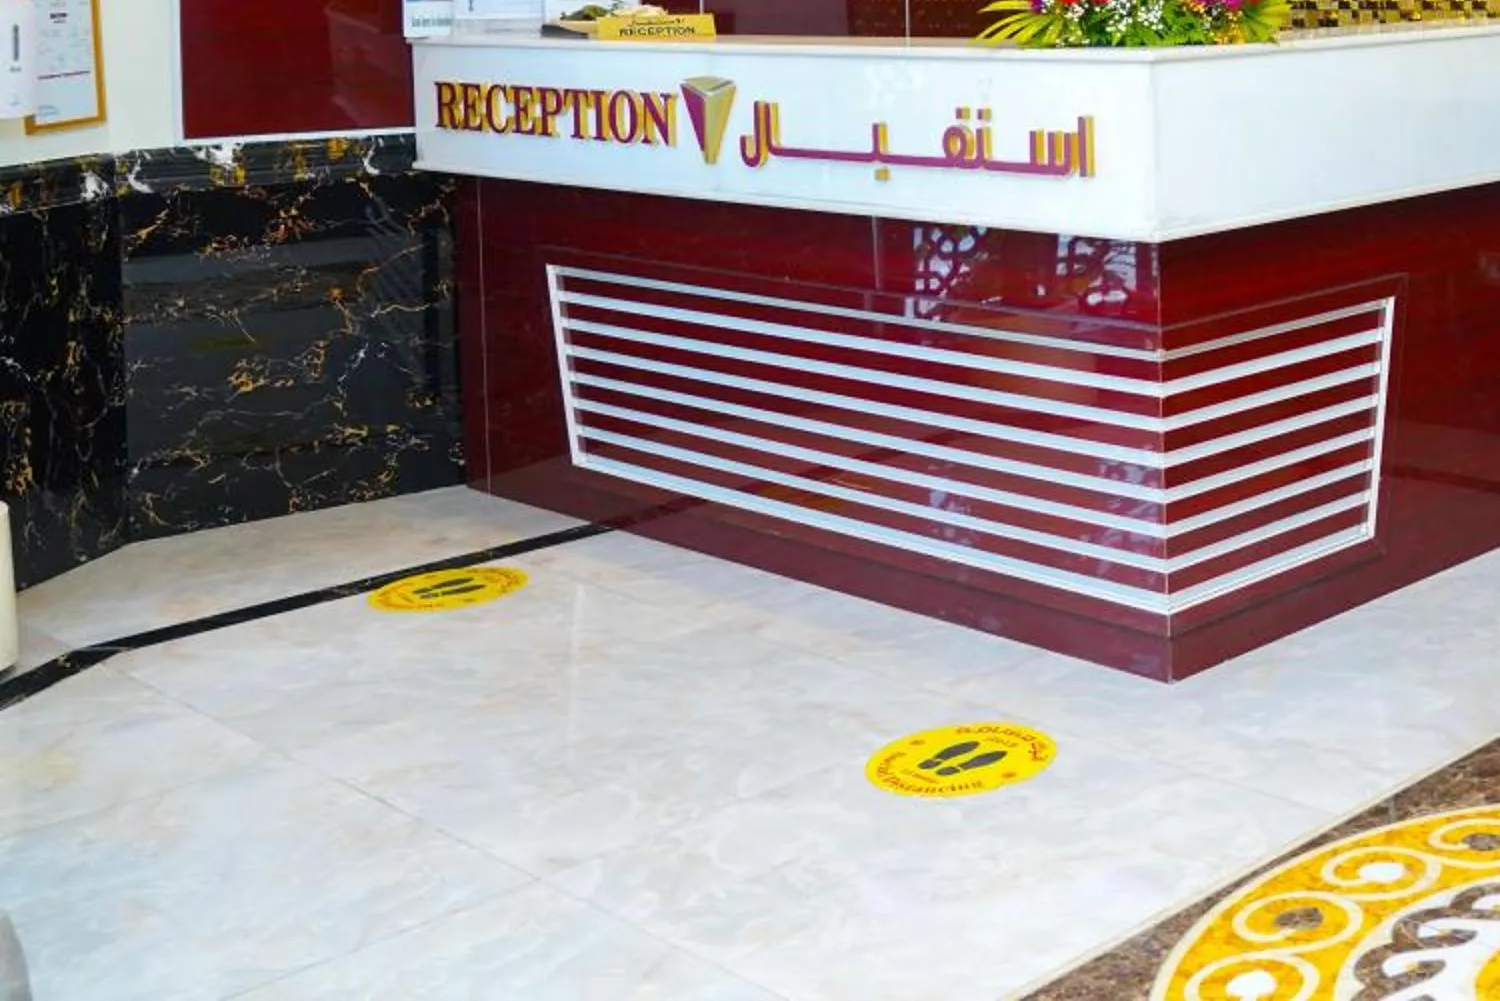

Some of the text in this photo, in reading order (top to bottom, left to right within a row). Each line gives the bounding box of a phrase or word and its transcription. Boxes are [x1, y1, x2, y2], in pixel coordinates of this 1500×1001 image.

[618, 26, 696, 38] RECEPTION
[433, 80, 679, 148] RECEPTION
[739, 100, 1095, 182] استقبال
